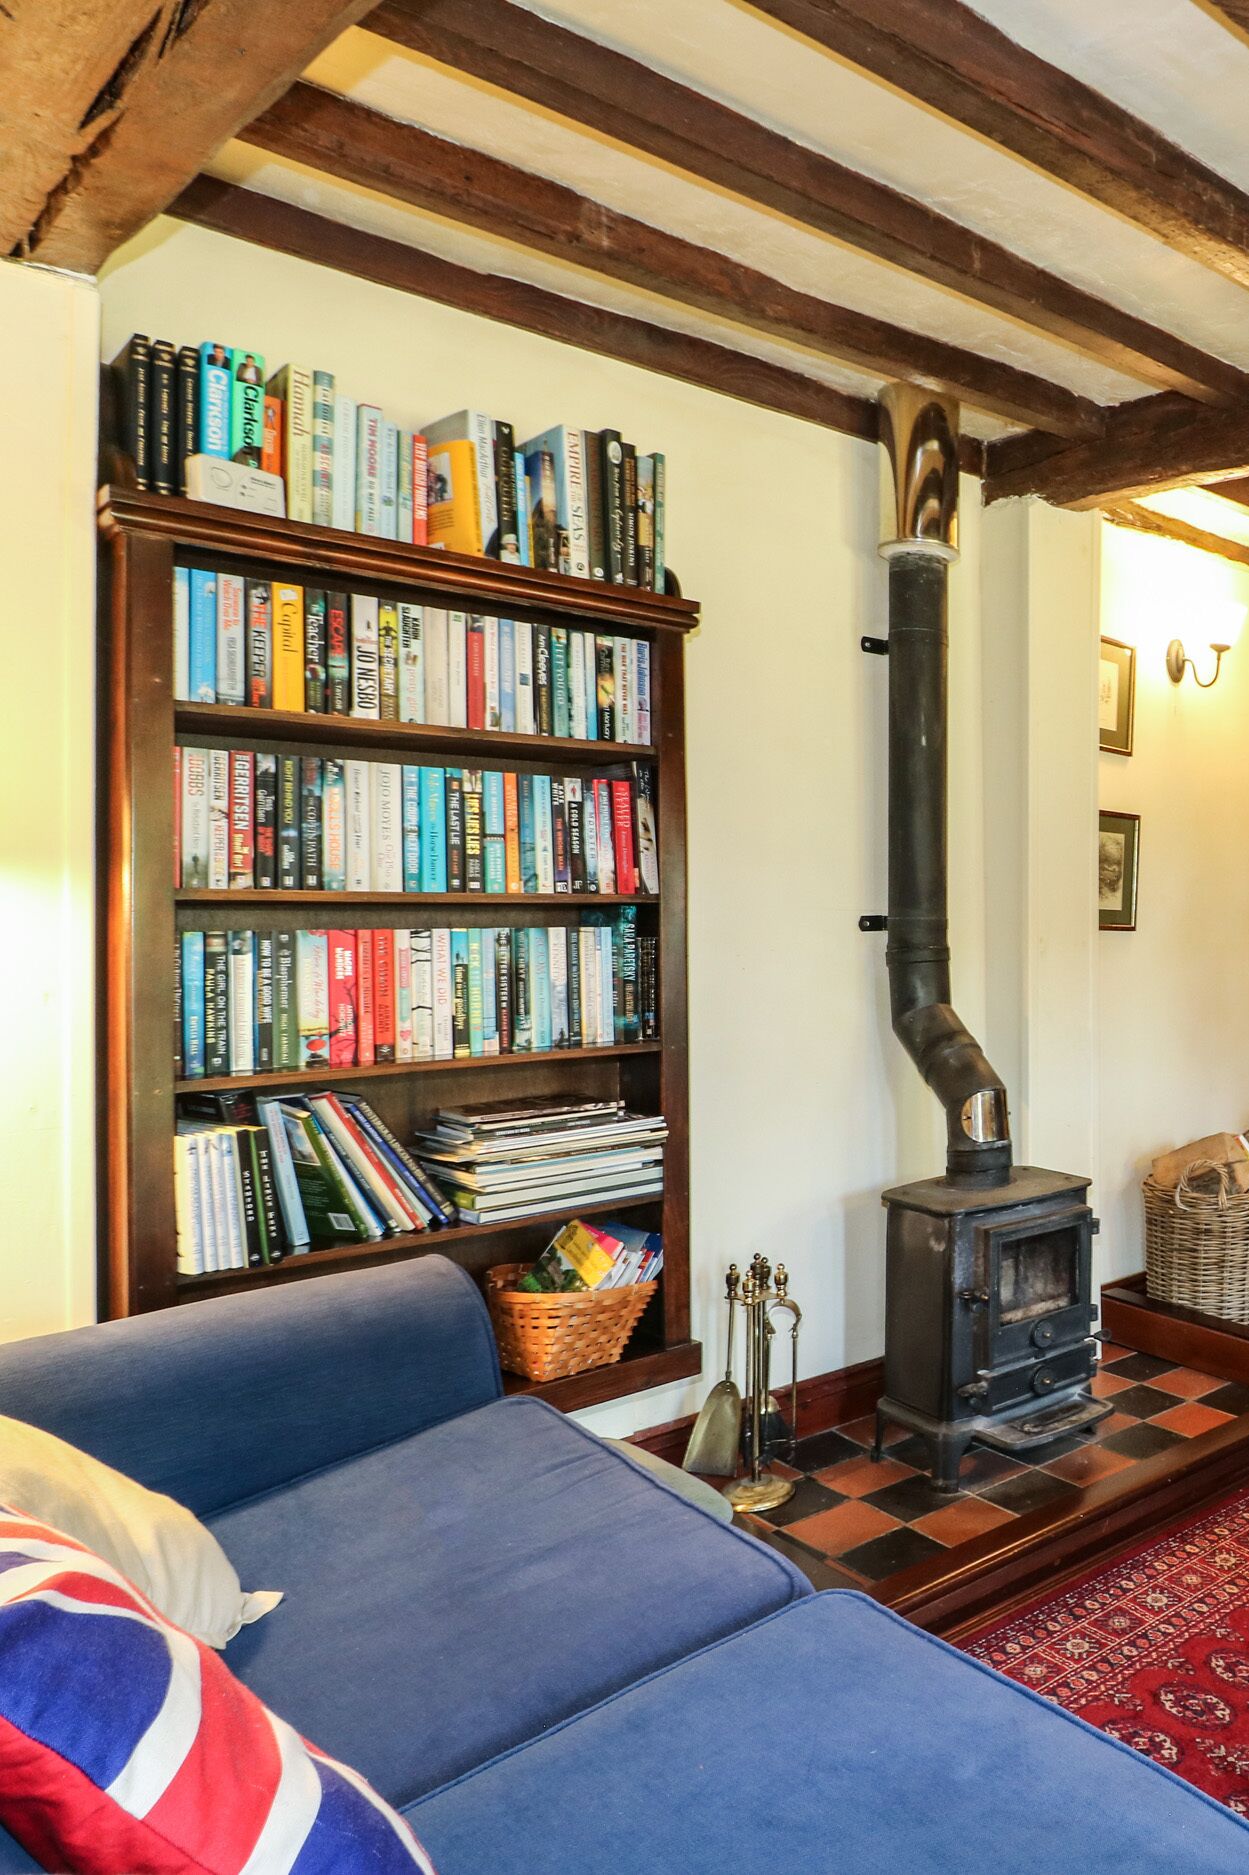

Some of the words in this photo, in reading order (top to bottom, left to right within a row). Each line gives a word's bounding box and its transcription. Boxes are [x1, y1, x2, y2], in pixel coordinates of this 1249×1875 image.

[208, 369, 228, 451] Clarkson
[293, 370, 310, 437] Hannah
[243, 386, 259, 455] Clarkson
[368, 419, 378, 437] TIM
[476, 414, 487, 434] Ellen
[368, 439, 377, 477] MOORE
[415, 443, 427, 459] VERY
[479, 436, 489, 478] MacArthur
[567, 432, 581, 489] EMPIRE
[416, 460, 427, 486] BRITISH
[416, 487, 427, 520] PROBLEMS
[572, 505, 584, 541] SEAS
[627, 537, 635, 566] JENKINS
[252, 604, 267, 629] THE
[277, 603, 298, 653] Capital
[402, 606, 411, 648] SLAUGHTER
[411, 618, 420, 640] KARIN
[307, 615, 324, 662] Teacher
[252, 630, 266, 678] KEEPER
[356, 646, 376, 663] JO
[637, 643, 647, 663] Boris
[383, 648, 394, 695] SECRETARY
[536, 648, 549, 685] Cleeves
[637, 665, 647, 696] Johnson
[557, 690, 565, 705] GO
[188, 760, 205, 796] DOBBS
[213, 757, 226, 801] GERRITSEN
[284, 760, 293, 780] RIGHT
[234, 761, 250, 830] GERRITSEN
[284, 782, 293, 807] BEHIND
[381, 771, 391, 798] JOJO
[407, 786, 417, 800] THE
[257, 790, 267, 822] Gerritsen
[450, 792, 459, 809] THE
[465, 794, 480, 813] LIES
[284, 808, 293, 823] YOU
[306, 806, 317, 839] COFFIN
[382, 800, 391, 841] MOYES
[407, 801, 417, 830] COUPLE
[451, 810, 459, 831] LAST
[466, 815, 480, 833] LIES
[408, 832, 417, 850] NEXT
[451, 832, 459, 845] LIE
[466, 836, 480, 854] LIES
[307, 841, 317, 866] PATH
[328, 834, 340, 870] HOUSE
[409, 853, 418, 873] DOOR
[430, 854, 438, 881] Dancer
[378, 937, 388, 955] THE
[623, 923, 636, 943] SARA
[261, 940, 271, 956] HOW
[436, 934, 447, 963] WHAT
[217, 955, 225, 971] THE
[262, 958, 271, 967] TO
[262, 968, 272, 977] BE
[335, 948, 345, 979] MURDERS
[345, 950, 353, 976] MAGPIE
[623, 944, 636, 981] PARETSKY
[205, 969, 215, 998] PAULA
[217, 974, 226, 993] GIRL
[275, 957, 293, 1009] Blasphemer
[379, 960, 389, 997] CHAIN
[437, 968, 448, 984] WE
[500, 976, 508, 1000] SISTER
[217, 996, 226, 1008] ON
[263, 985, 272, 1005] GOOD
[437, 987, 447, 1005] DID
[206, 1002, 216, 1044] HAWKINS
[217, 1011, 226, 1027] THE
[263, 1006, 272, 1023] WIFE
[454, 998, 466, 1030] goodbye
[217, 1029, 226, 1054] TRAIN
[242, 1170, 255, 1221] STAMFORD
